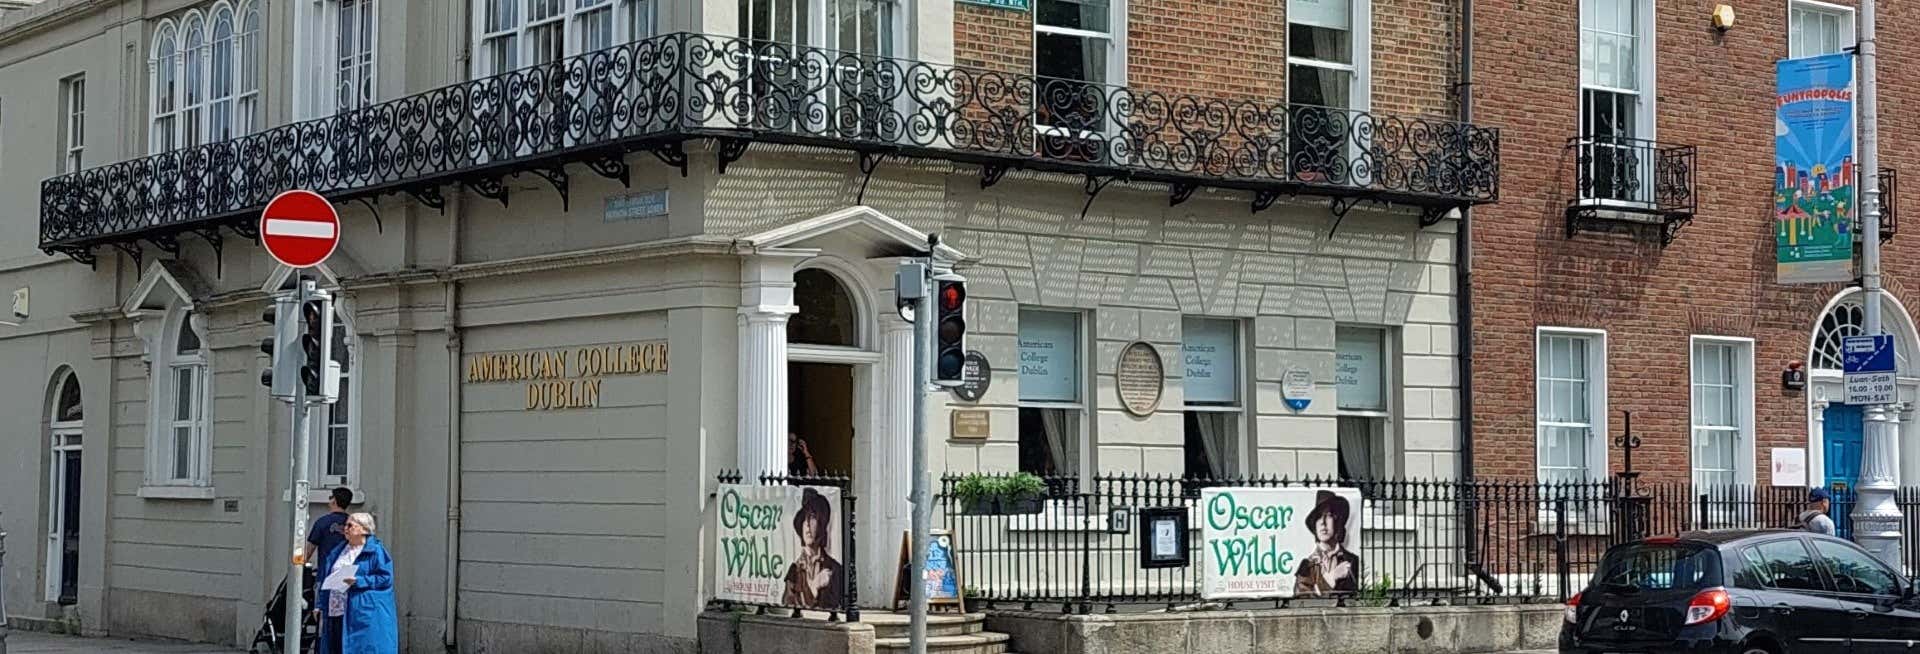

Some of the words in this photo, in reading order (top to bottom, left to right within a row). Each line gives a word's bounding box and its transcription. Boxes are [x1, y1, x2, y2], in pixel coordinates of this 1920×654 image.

[1018, 340, 1054, 349] American
[1182, 344, 1215, 352] American
[468, 350, 567, 384] AMERICAN
[577, 343, 669, 377] COLLEGE
[1021, 351, 1048, 364] College
[1185, 354, 1211, 366] College
[1022, 365, 1048, 376] Dublin
[1187, 368, 1211, 377] Dublin
[526, 379, 601, 410] DUBLIN
[1851, 394, 1890, 402] MON-SAT
[721, 489, 783, 535] Oscar
[1208, 492, 1294, 535] Oscar
[1115, 513, 1125, 528] H
[721, 536, 783, 579] Wilde
[1209, 534, 1293, 576] Wilde
[1255, 580, 1275, 588] VISIT
